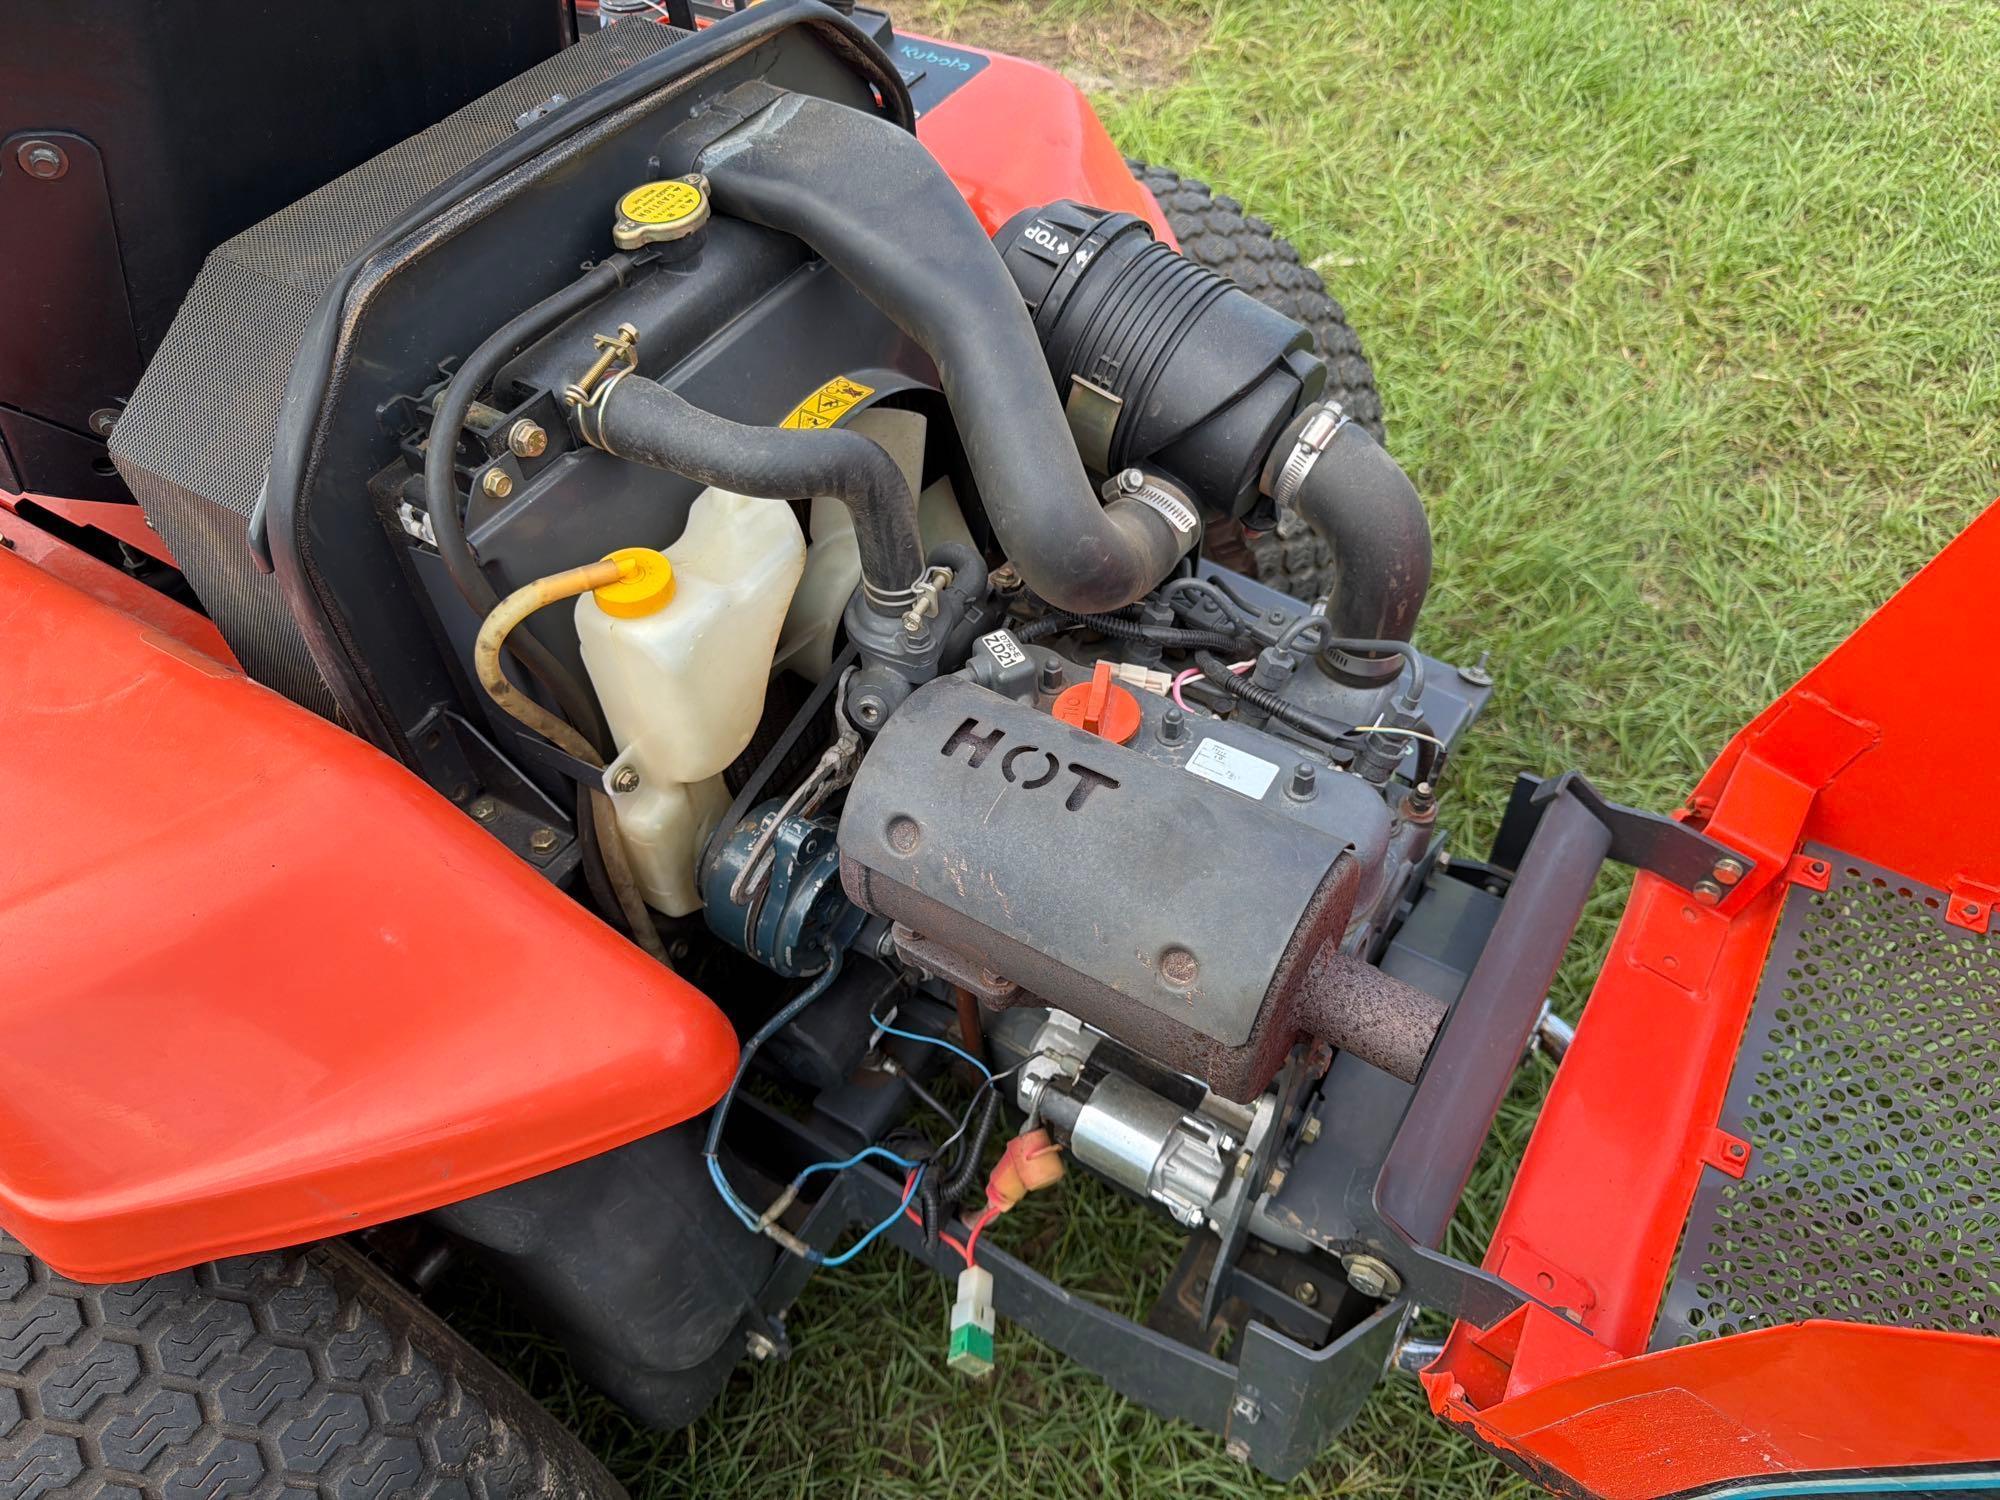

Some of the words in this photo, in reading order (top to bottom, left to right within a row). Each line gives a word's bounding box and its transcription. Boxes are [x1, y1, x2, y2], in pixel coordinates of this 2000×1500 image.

[902, 45, 971, 71] Kubota
[638, 193, 675, 218] CAUTION
[1024, 226, 1058, 251] TOP
[984, 635, 1016, 666] ZD21
[1060, 697, 1081, 720] OIL
[940, 717, 1121, 812] HOT
